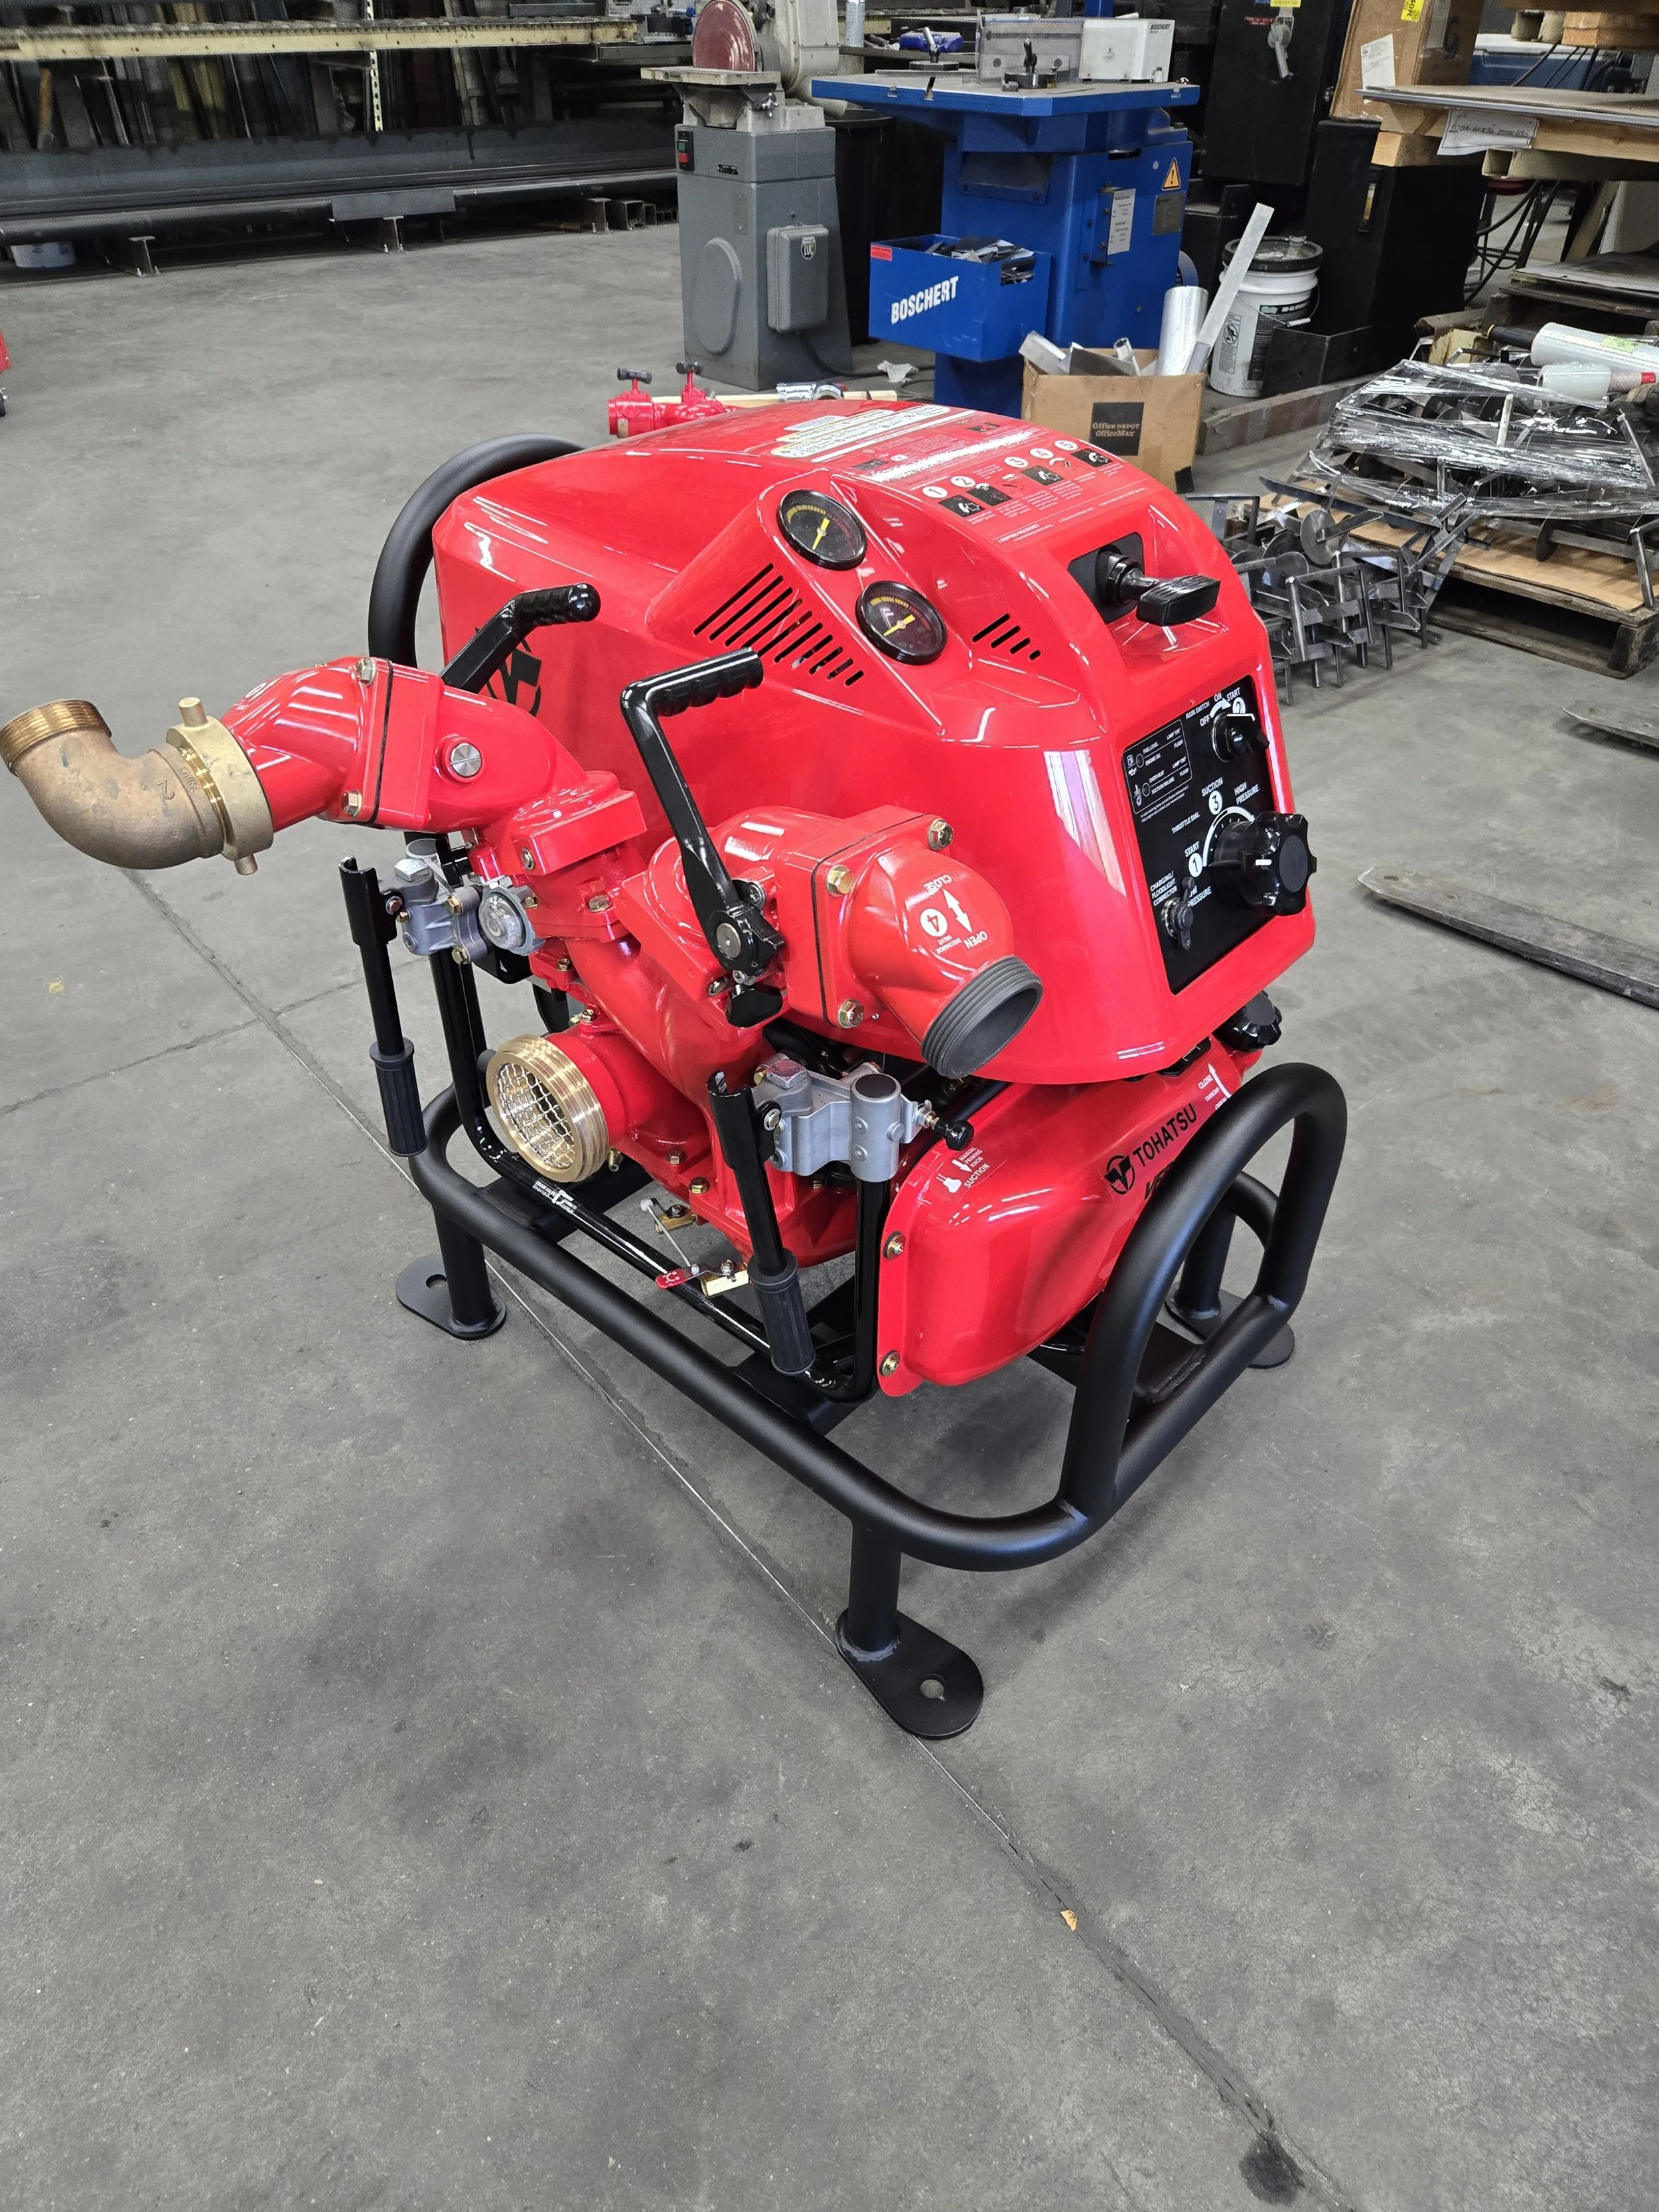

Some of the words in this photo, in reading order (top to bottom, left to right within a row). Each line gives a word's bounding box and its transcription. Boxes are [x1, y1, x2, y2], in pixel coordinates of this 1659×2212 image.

[891, 276, 959, 325] BOSCHERT
[1214, 692, 1222, 702] ON
[1226, 687, 1240, 701] START
[1185, 709, 1196, 719] MAIN
[1195, 701, 1210, 713] SWITCH
[1200, 714, 1210, 727] OFF
[1201, 777, 1223, 796] SUCTION
[1234, 782, 1247, 796] HIGH
[1236, 784, 1260, 805] PRESSURE
[1171, 816, 1191, 834] THROTTLE
[1190, 812, 1200, 823] DIAL
[1185, 841, 1200, 857] START
[923, 874, 952, 895] CLOSE
[1150, 870, 1174, 892] CHARGING/
[1151, 878, 1176, 899] FLOODLIGHT
[1153, 885, 1178, 907] CONNECTOR
[935, 937, 962, 955] DISCHARGE
[936, 934, 953, 946] VALVE
[964, 930, 987, 949] OPEN
[1198, 1074, 1214, 1089] CLOSE
[1132, 1103, 1197, 1167] TOHATSU
[958, 1146, 977, 1161] MANUAL
[964, 1149, 983, 1164] PRIMING
[970, 1156, 983, 1167] KNOB
[964, 1163, 990, 1188] SUCTION
